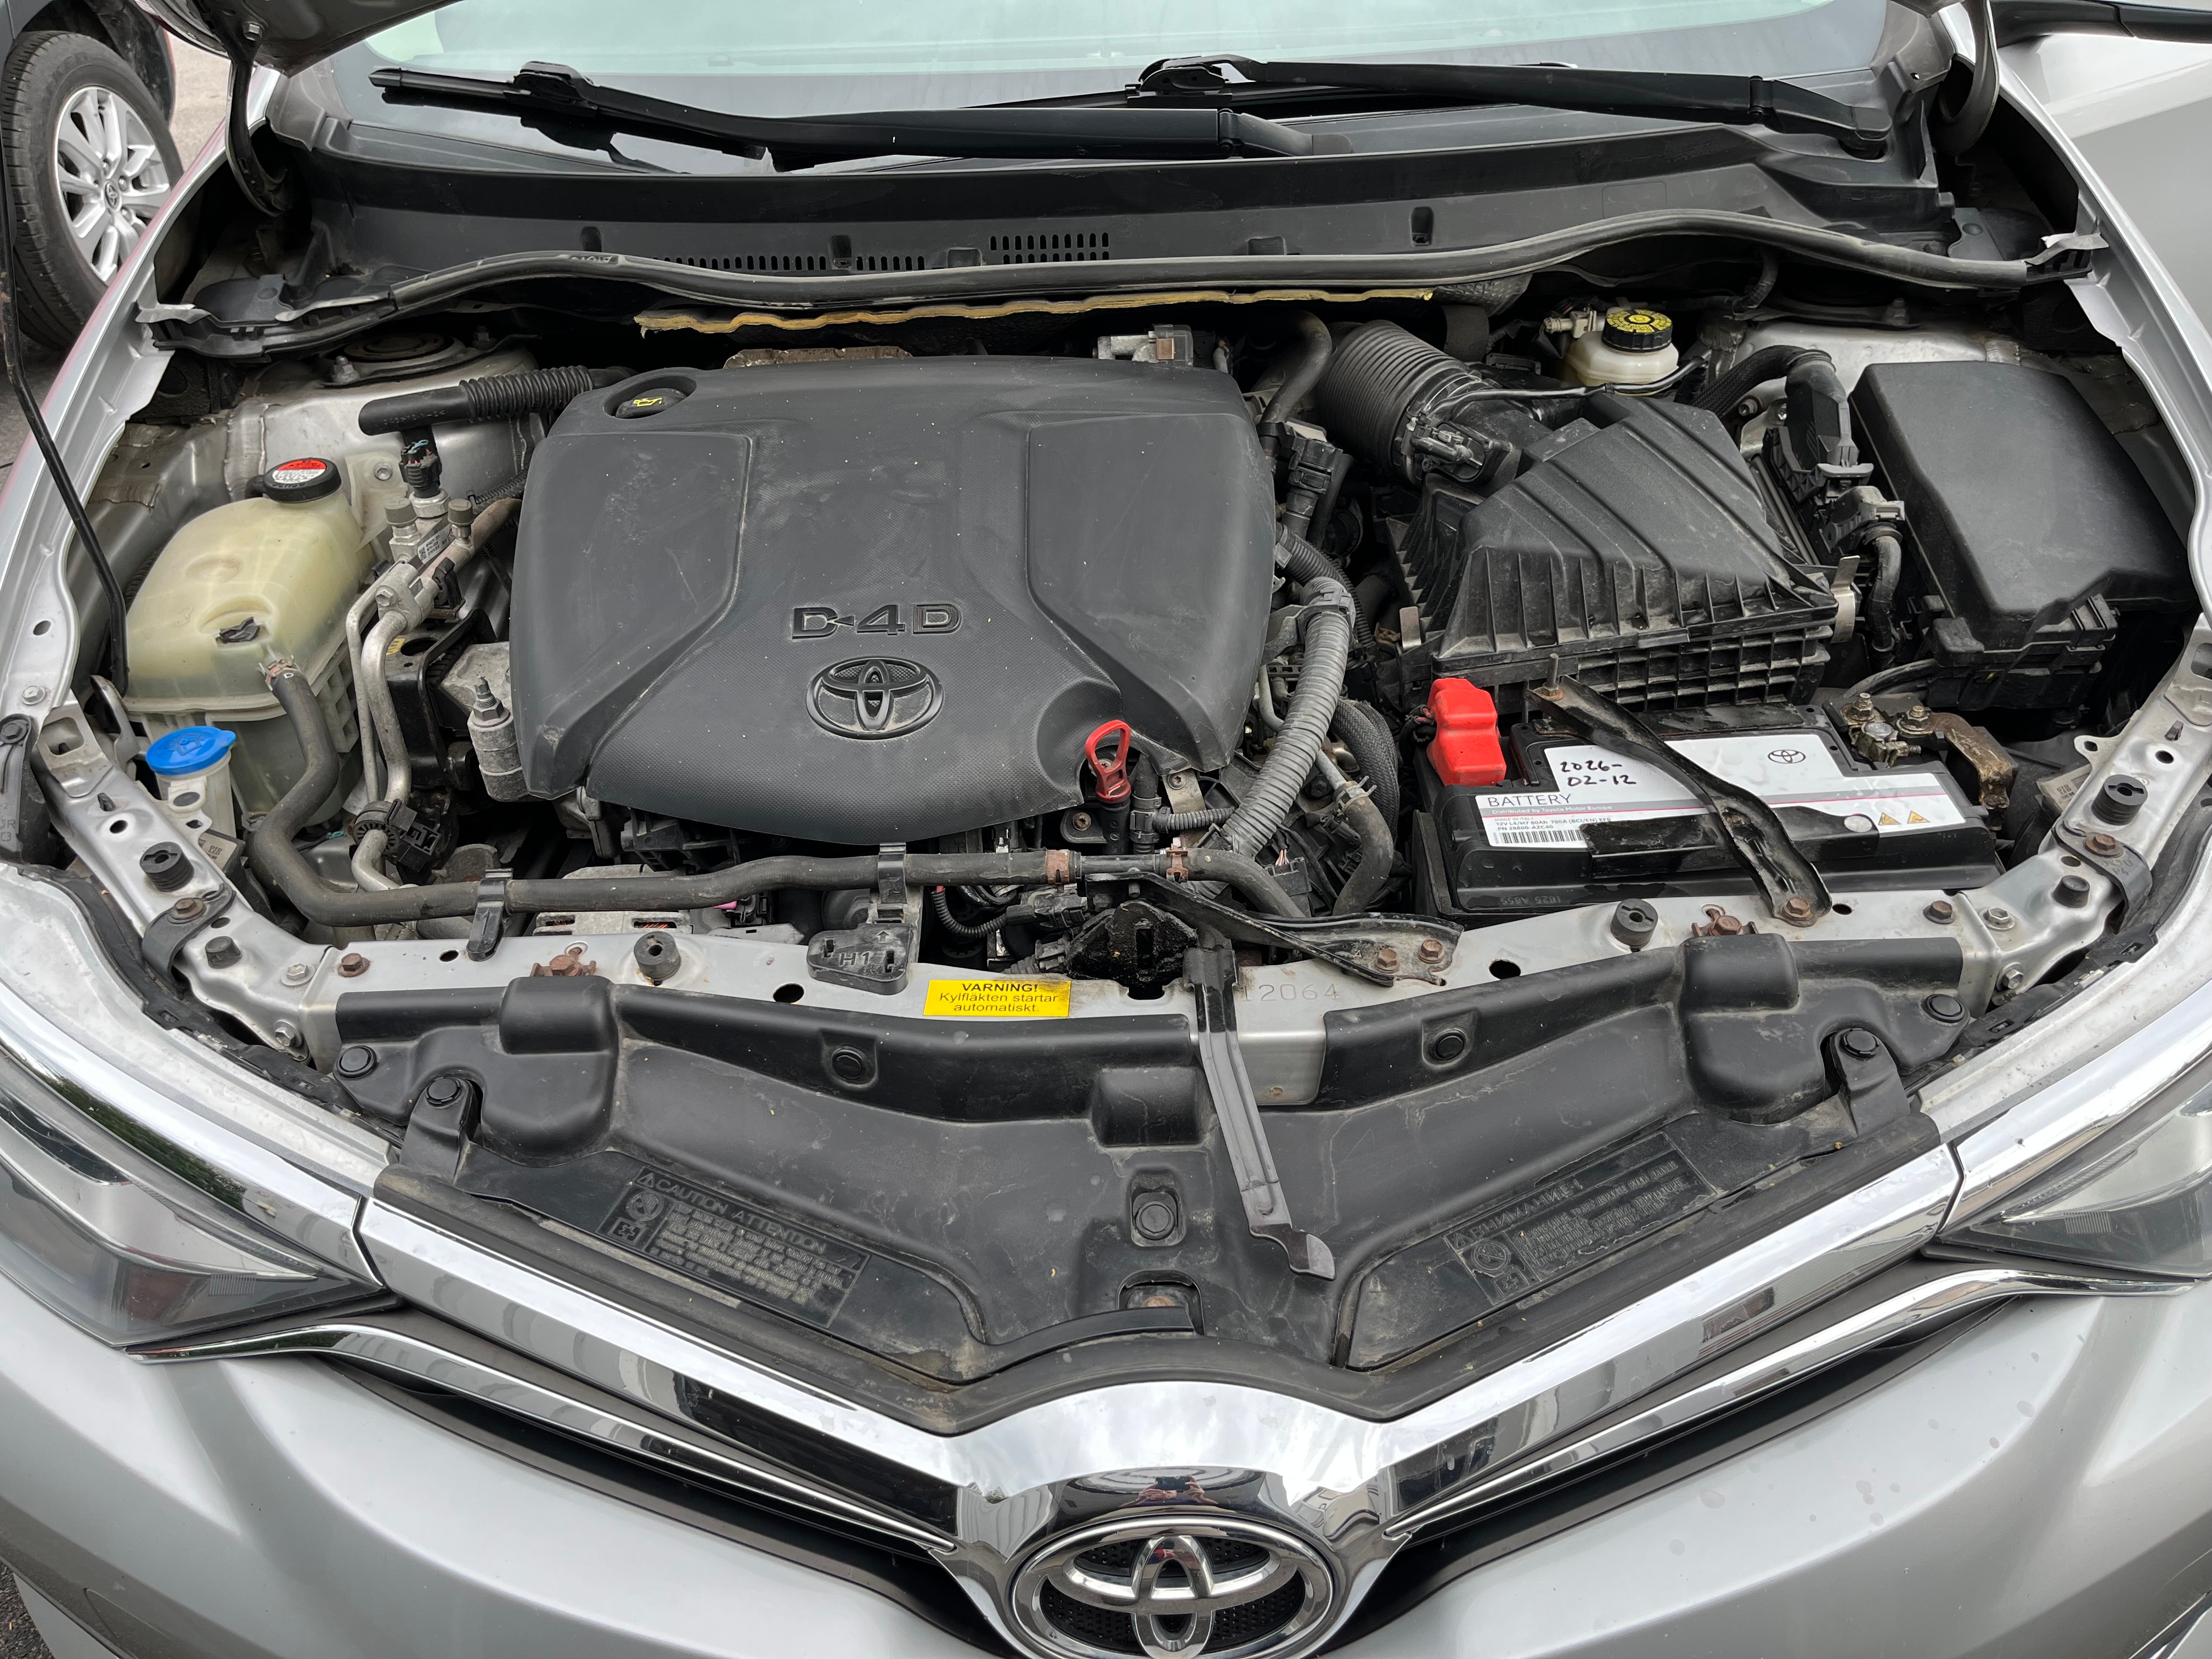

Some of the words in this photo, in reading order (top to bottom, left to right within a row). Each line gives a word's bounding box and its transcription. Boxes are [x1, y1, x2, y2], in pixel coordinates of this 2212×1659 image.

[1560, 760, 1622, 772] 2026-
[1567, 775, 1637, 787] 02-12
[1487, 793, 1571, 807] BATTERY
[839, 952, 870, 966] H1
[962, 984, 1038, 992] VARNING!
[940, 993, 1008, 1003] Kylfläkten
[1013, 994, 1058, 1002] startar
[953, 1003, 1039, 1012] automatiskt.
[657, 1180, 729, 1215] CAUTION
[732, 1211, 827, 1255] ATTENTION
